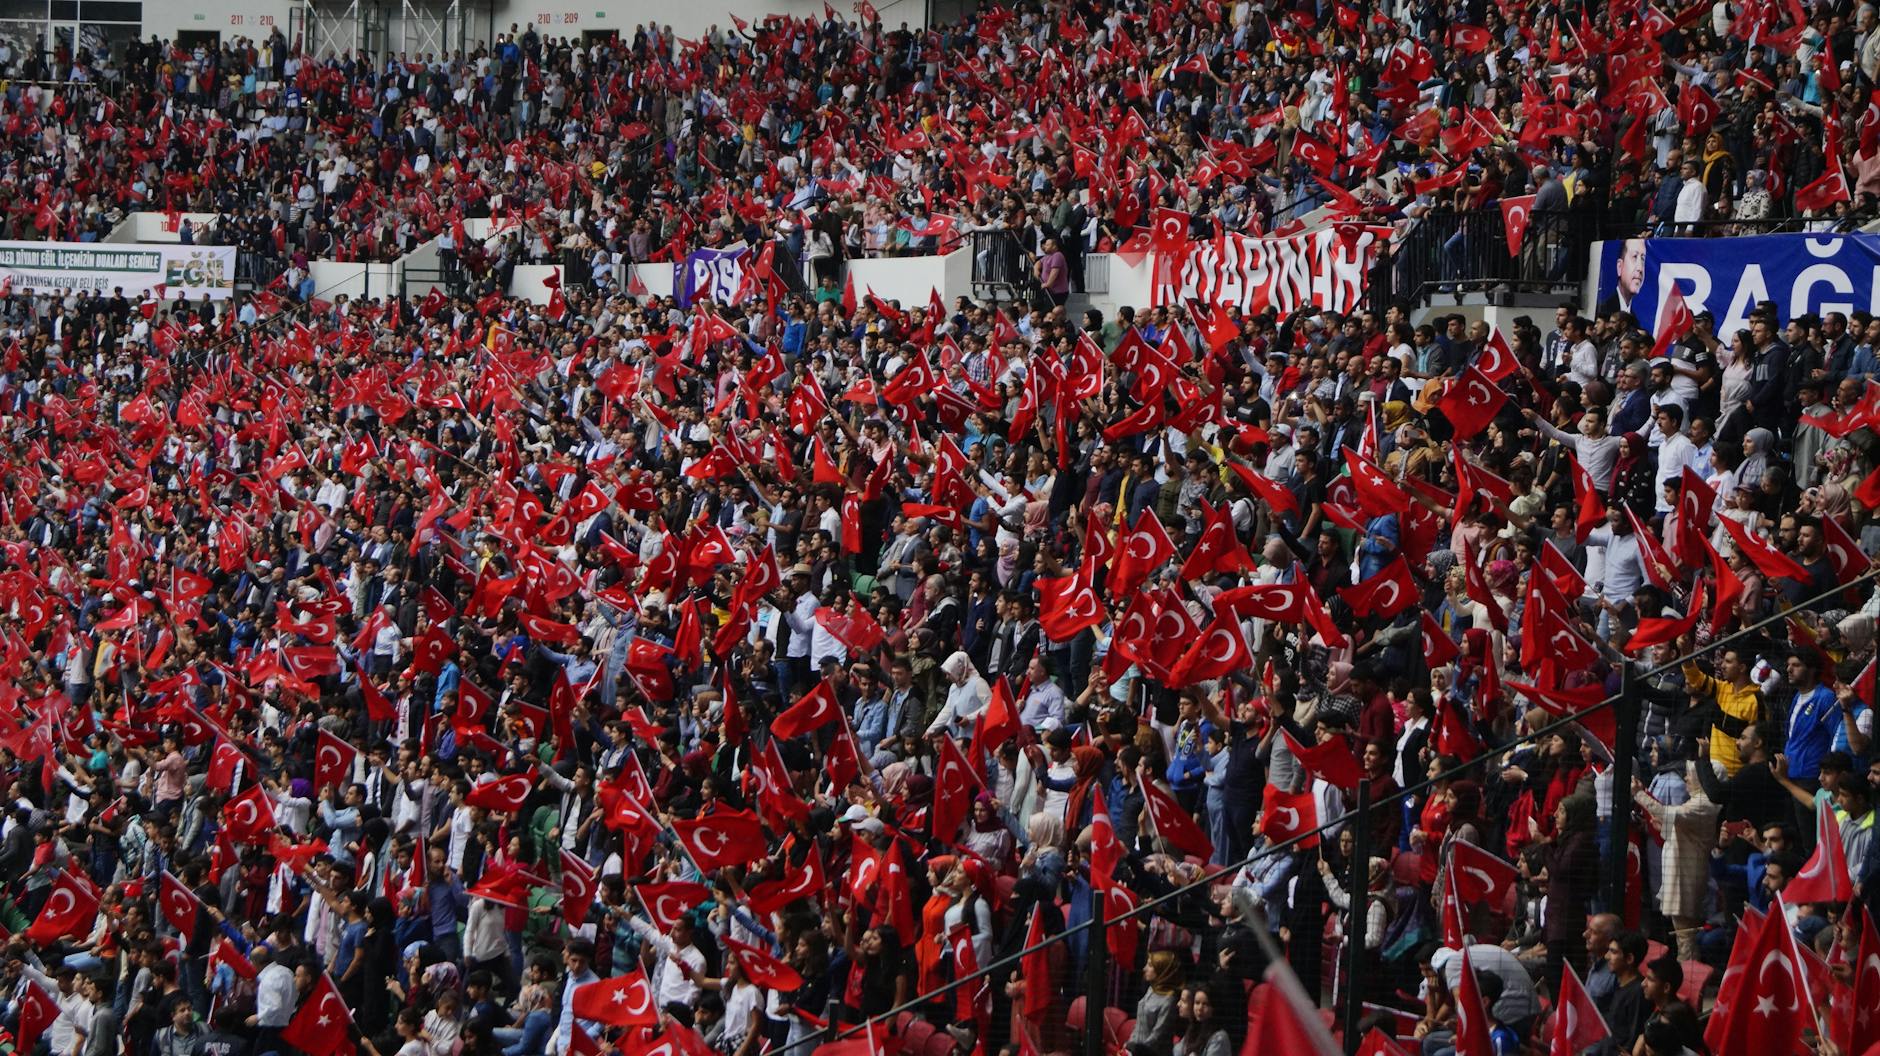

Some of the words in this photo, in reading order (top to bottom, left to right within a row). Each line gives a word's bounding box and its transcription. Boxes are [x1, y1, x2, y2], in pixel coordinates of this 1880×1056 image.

[231, 14, 244, 25] 211
[260, 15, 274, 26] 210
[537, 13, 551, 24] 210
[564, 12, 579, 24] 209
[41, 250, 56, 267] EĞİL
[58, 250, 94, 269] İLÇEMİZİN
[96, 253, 127, 268] DUALARI
[128, 252, 159, 269] SENİNLE
[166, 251, 233, 288] EĞİL
[1652, 238, 1880, 347] BAĞ
